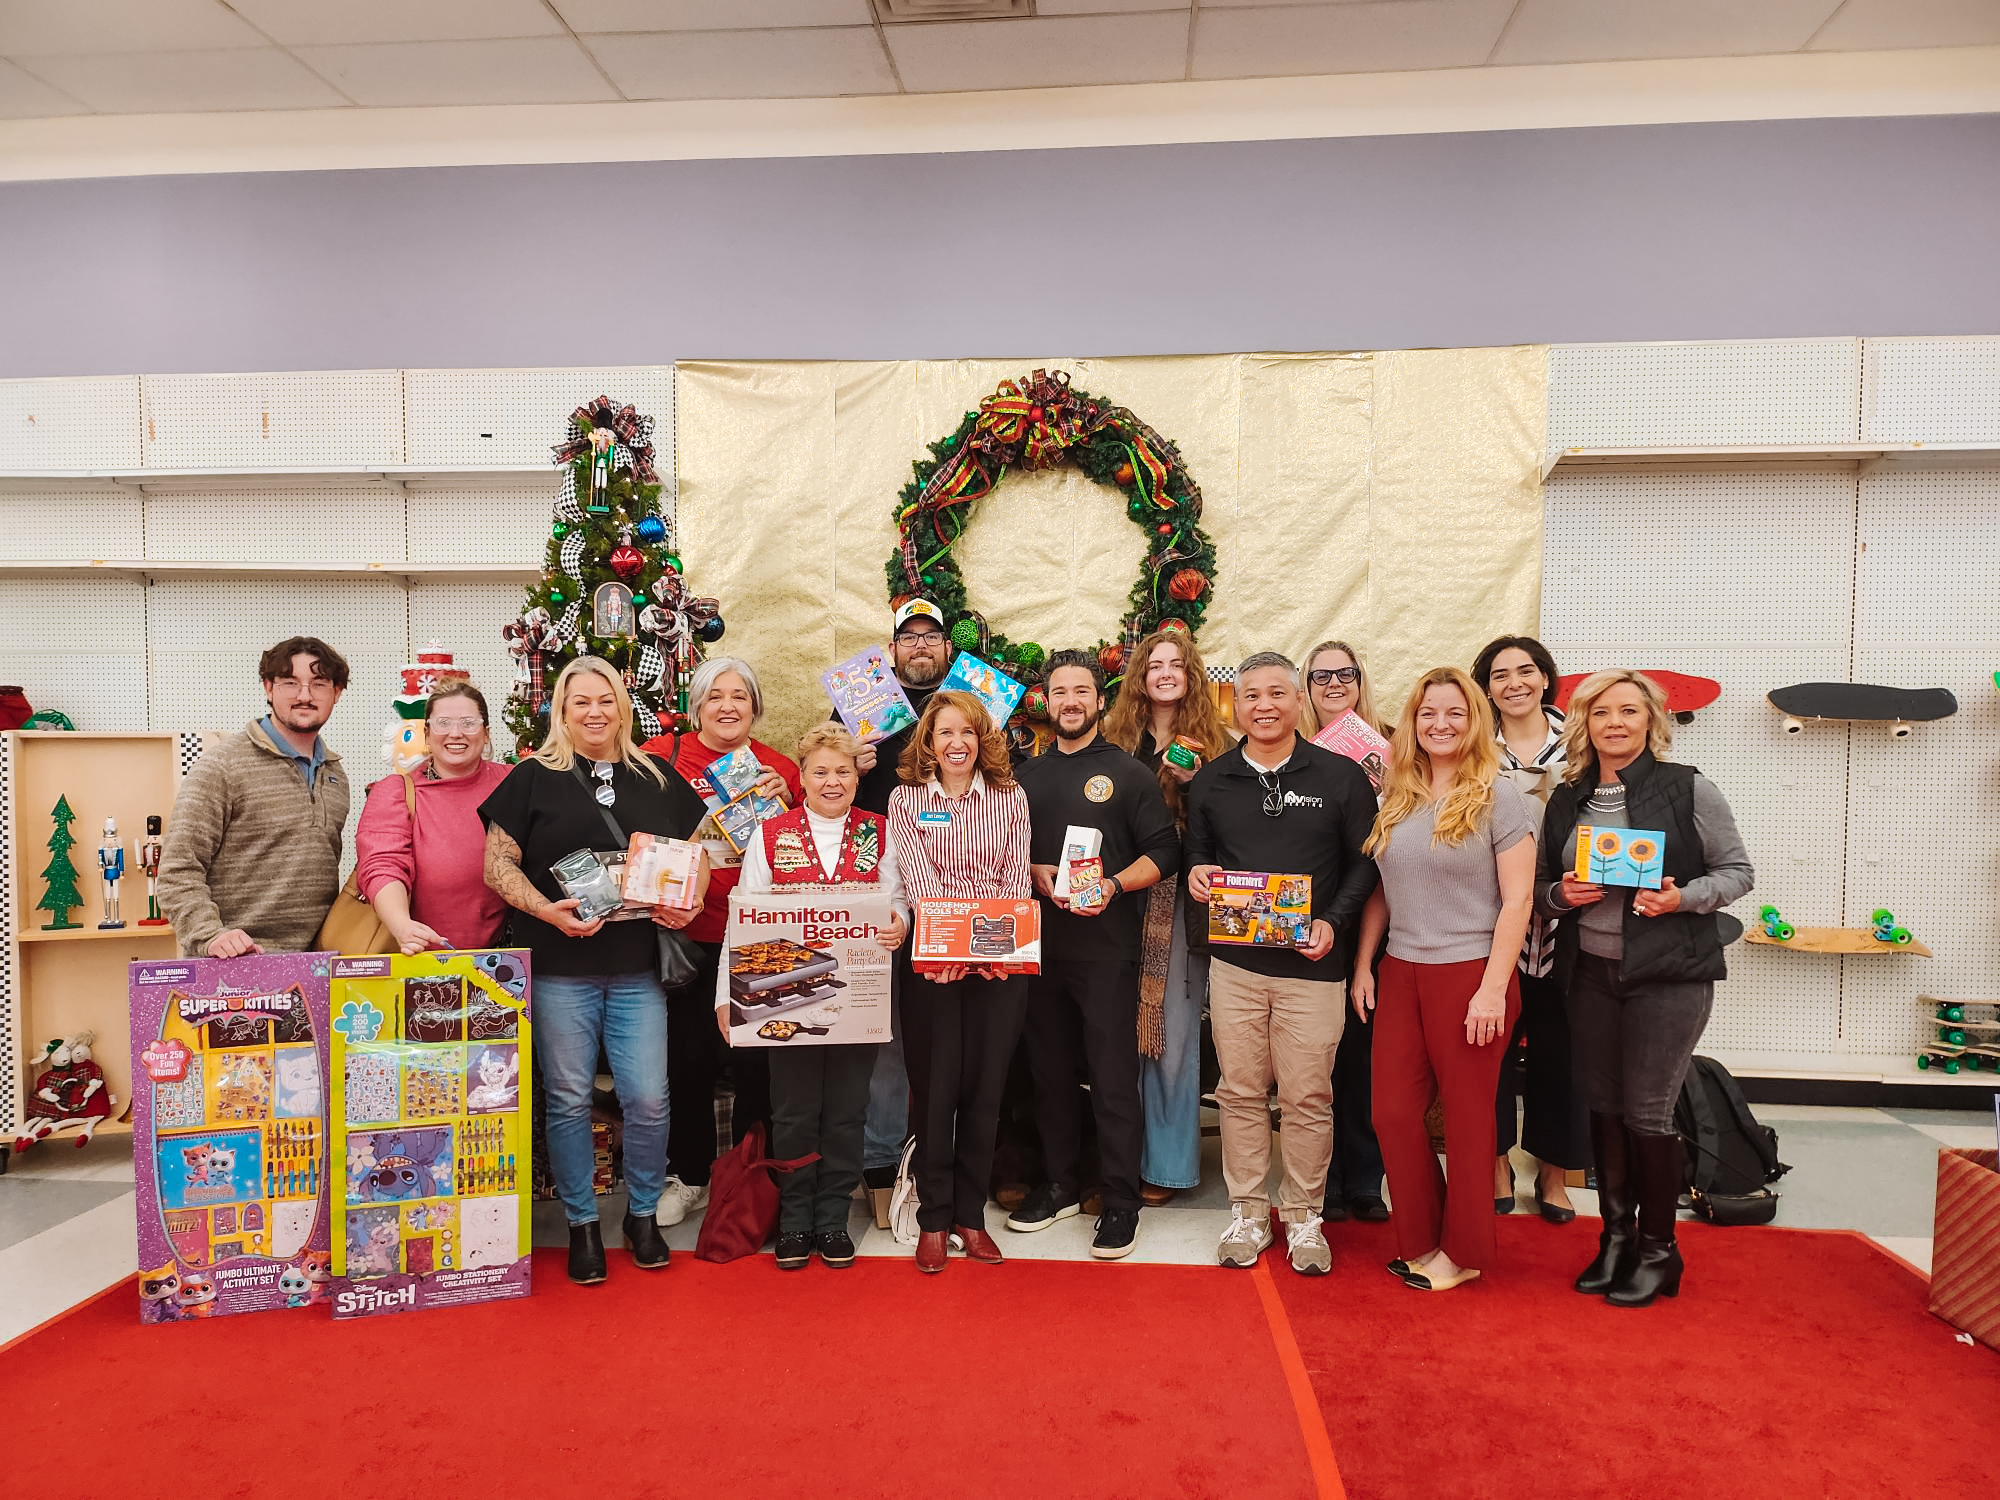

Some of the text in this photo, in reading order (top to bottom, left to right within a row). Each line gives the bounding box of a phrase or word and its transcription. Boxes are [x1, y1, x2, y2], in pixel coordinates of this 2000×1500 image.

[848, 666, 871, 698] 5
[1342, 717, 1364, 738] TOOLS
[1361, 735, 1377, 748] SET
[1346, 713, 1386, 749] HOUSEHOLD
[1070, 864, 1102, 890] UNO
[1226, 875, 1265, 888] FORTNITE
[921, 901, 980, 909] HOUSEHOLD
[738, 907, 850, 924] Hamilton
[803, 923, 878, 940] Beach
[352, 960, 385, 968] WARNING:
[155, 967, 190, 977] WARNING:
[179, 993, 292, 1017] SUPER KITTIES
[352, 1018, 369, 1026] 200
[150, 1050, 184, 1061] Over 250
[154, 1066, 180, 1077] Items!
[160, 1060, 174, 1068] Fun
[215, 1264, 282, 1280] JUMBO ULTIMATE
[435, 1267, 509, 1282] JUMBO STATIONERY
[222, 1274, 275, 1290] ACTIVITY SET
[442, 1275, 503, 1288] CREATIVITY SET
